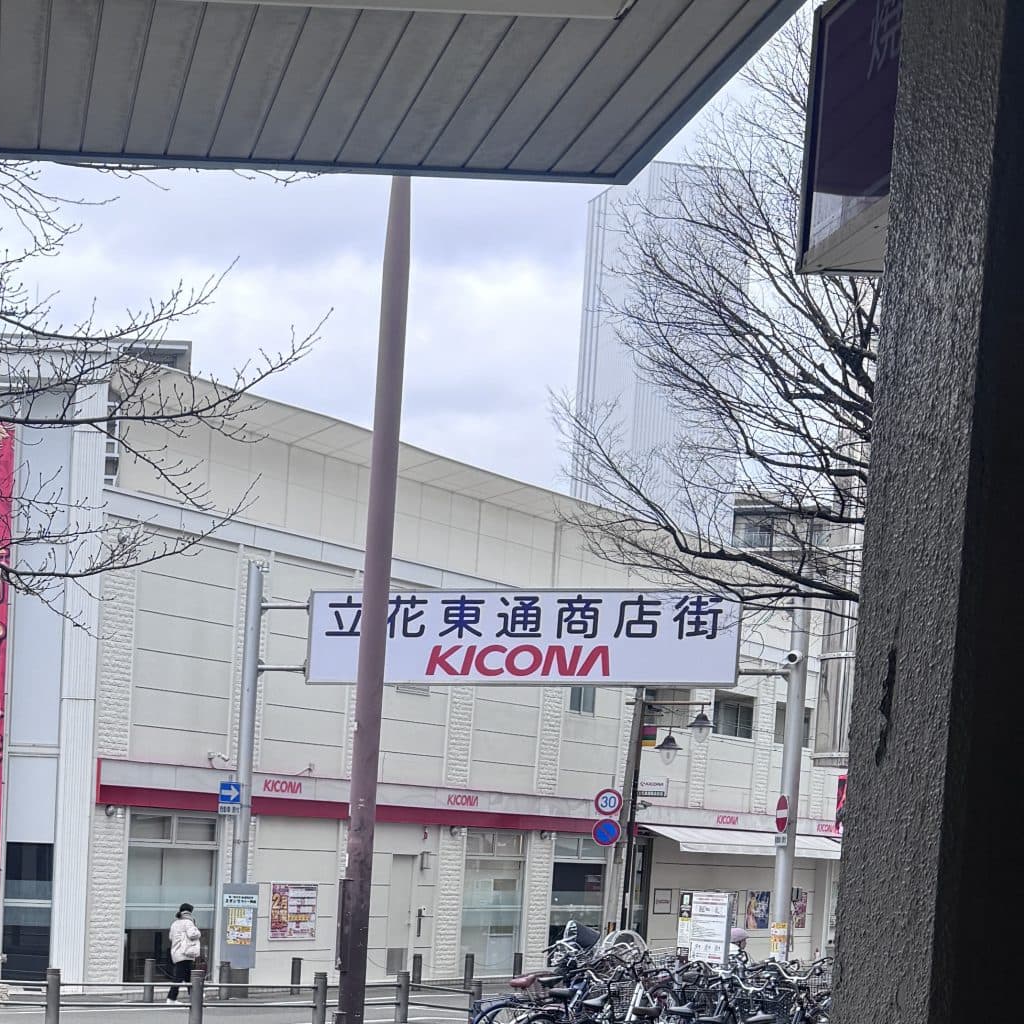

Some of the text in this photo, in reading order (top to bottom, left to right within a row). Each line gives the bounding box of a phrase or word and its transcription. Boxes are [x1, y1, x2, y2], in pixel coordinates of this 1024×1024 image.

[325, 594, 725, 641] 立花東通商店街
[425, 644, 611, 677] KICONA
[263, 778, 303, 795] KICONA
[447, 794, 479, 807] KICONA
[600, 795, 617, 809] 30
[716, 814, 739, 826] KICONA
